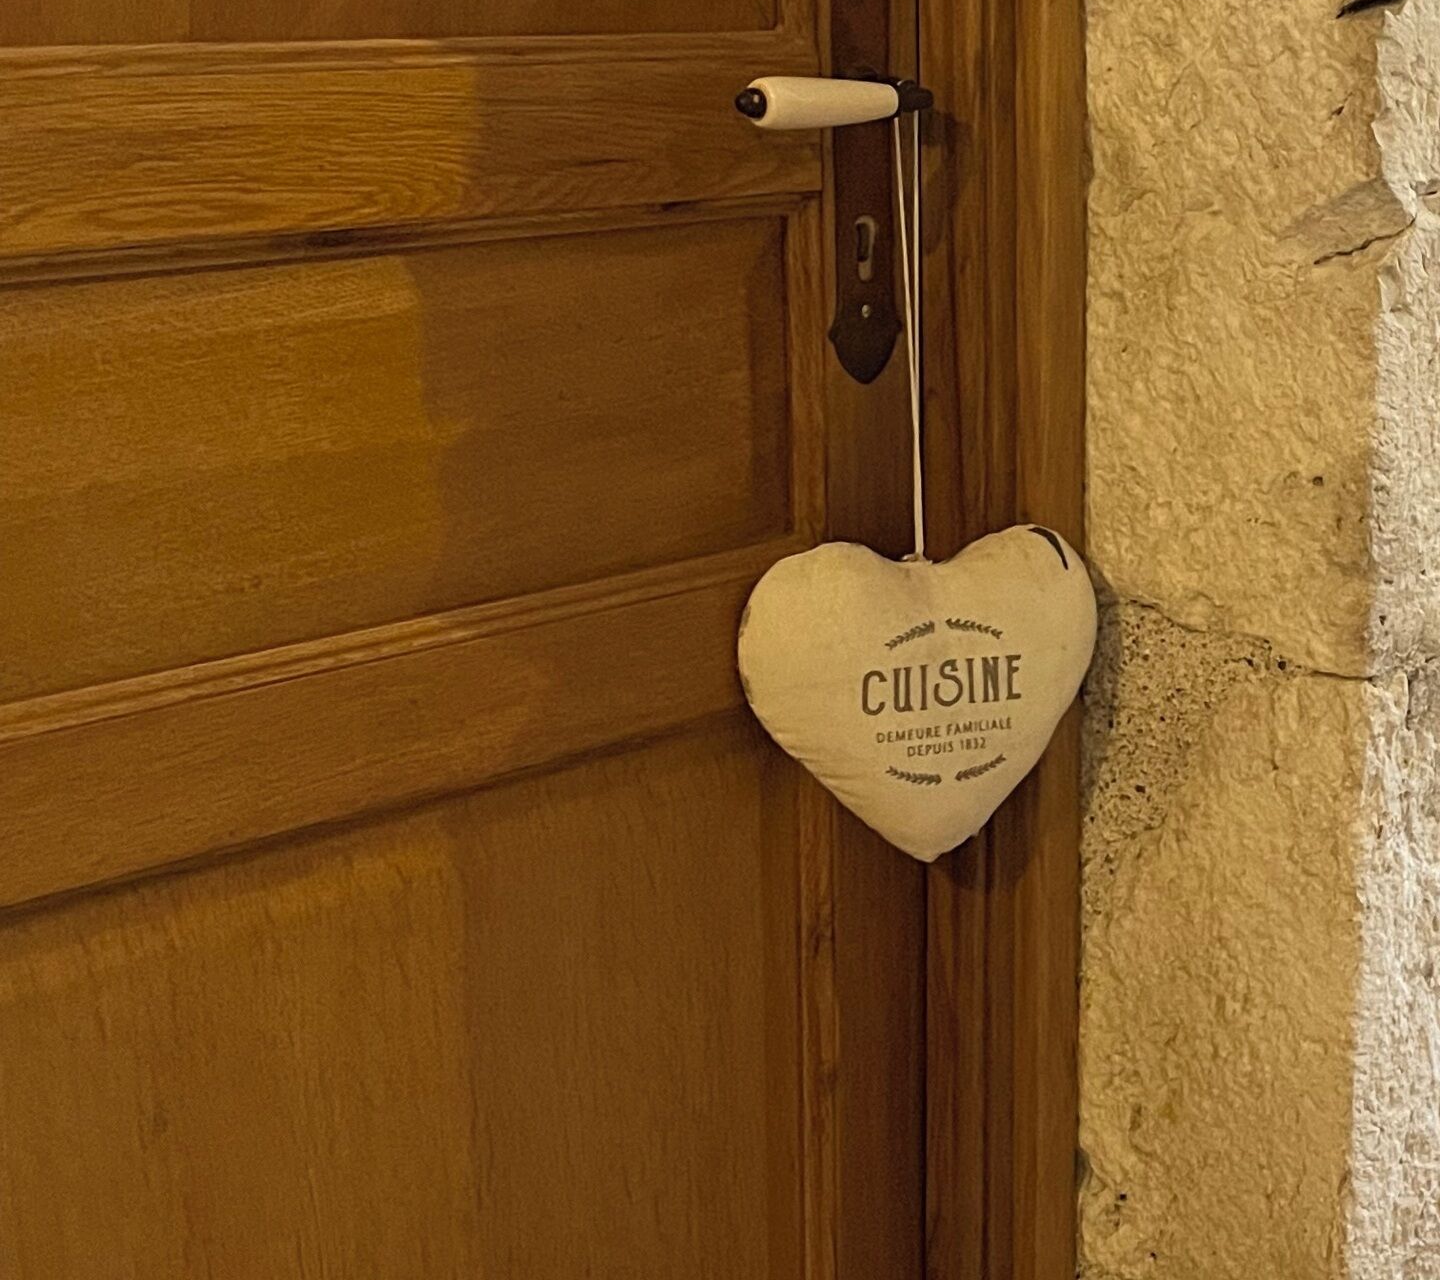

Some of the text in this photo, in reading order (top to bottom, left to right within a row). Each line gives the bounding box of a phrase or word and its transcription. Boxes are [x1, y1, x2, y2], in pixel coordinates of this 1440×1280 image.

[862, 654, 1021, 715] CUISINE
[876, 717, 1011, 743] DEMEURE FAMILIALE
[907, 740, 954, 757] DEPUIS
